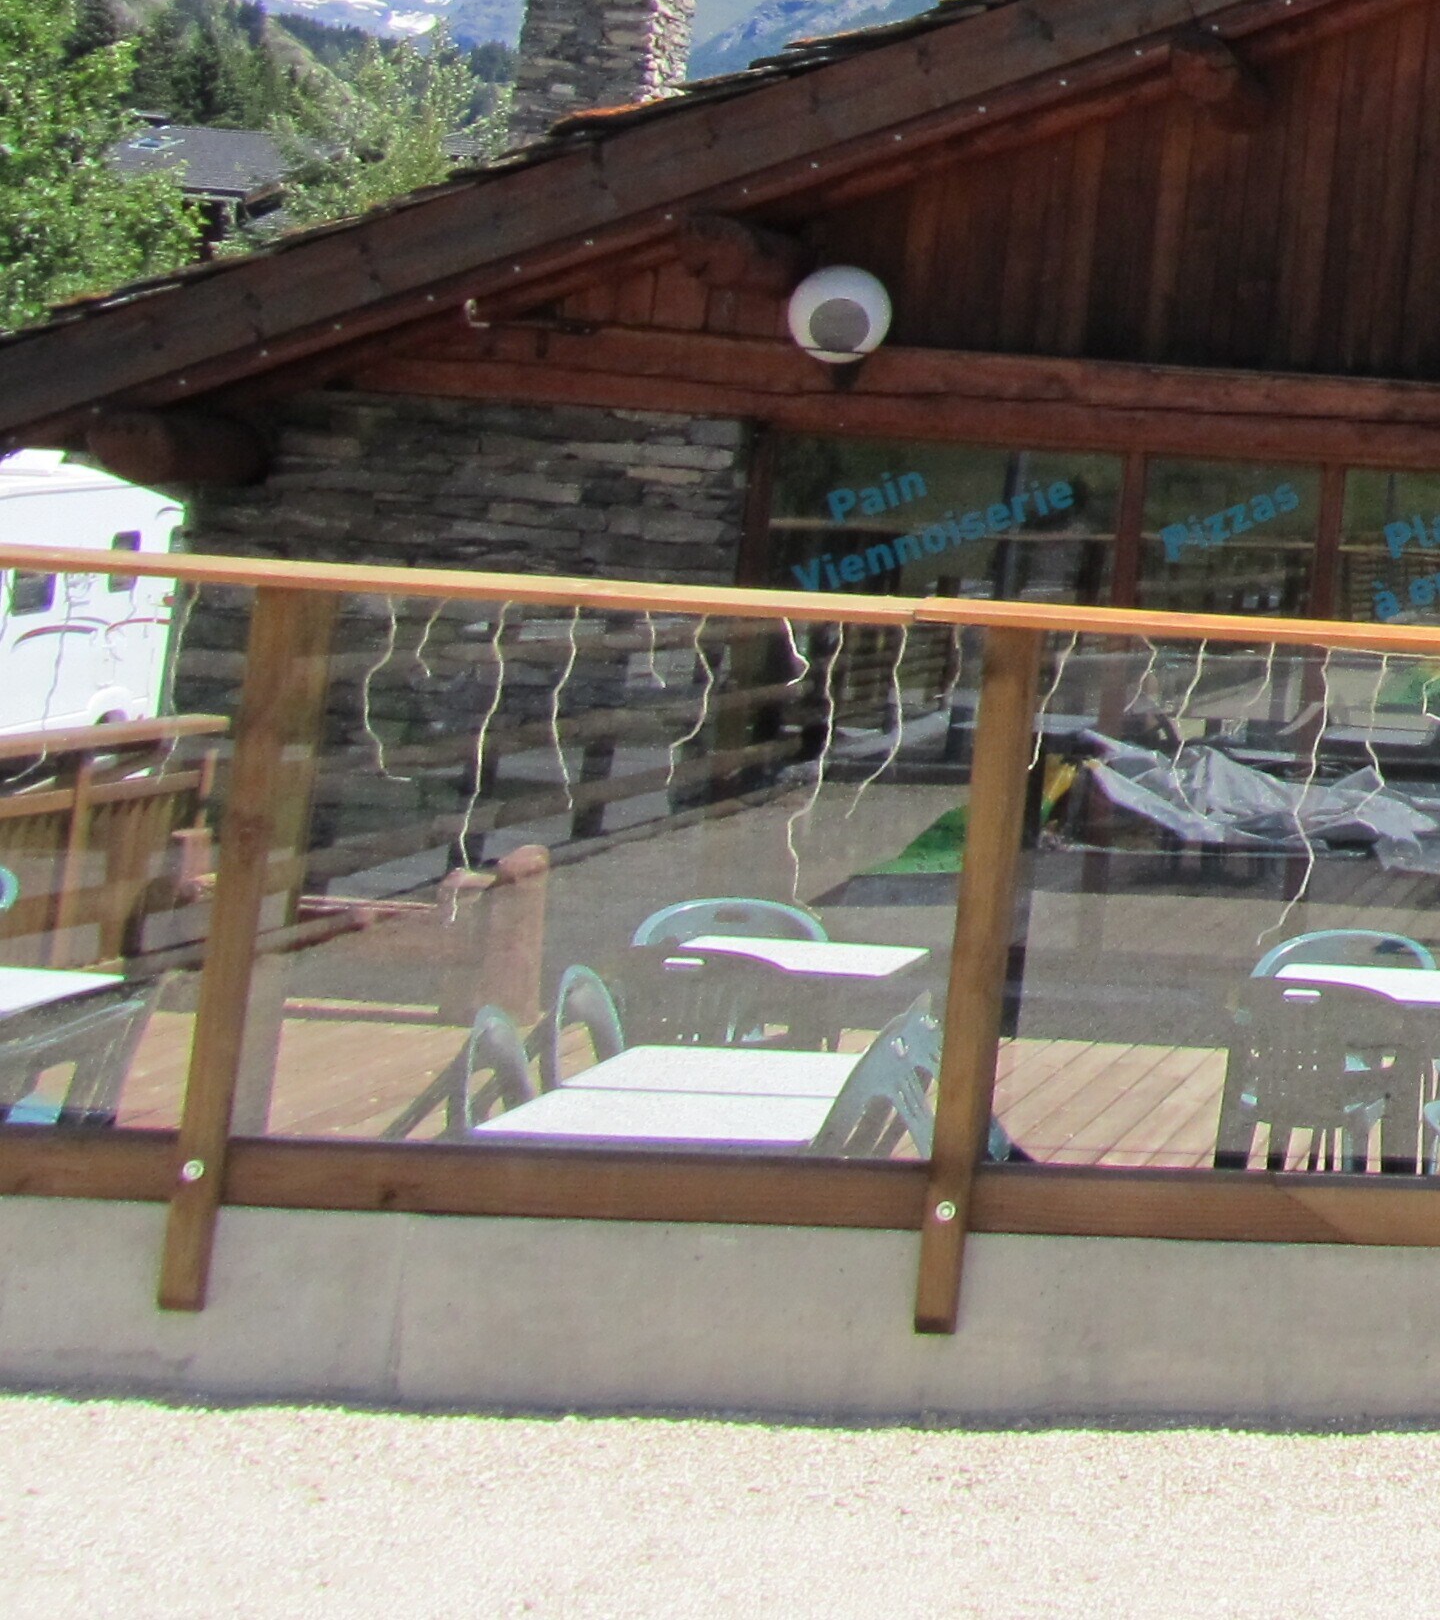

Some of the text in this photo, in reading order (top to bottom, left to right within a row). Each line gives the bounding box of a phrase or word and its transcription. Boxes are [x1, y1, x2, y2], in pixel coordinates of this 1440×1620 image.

[826, 471, 928, 524] Pain
[1159, 482, 1300, 564] Pizzas
[791, 479, 1075, 592] Viennoiserie
[1372, 581, 1401, 620] à
